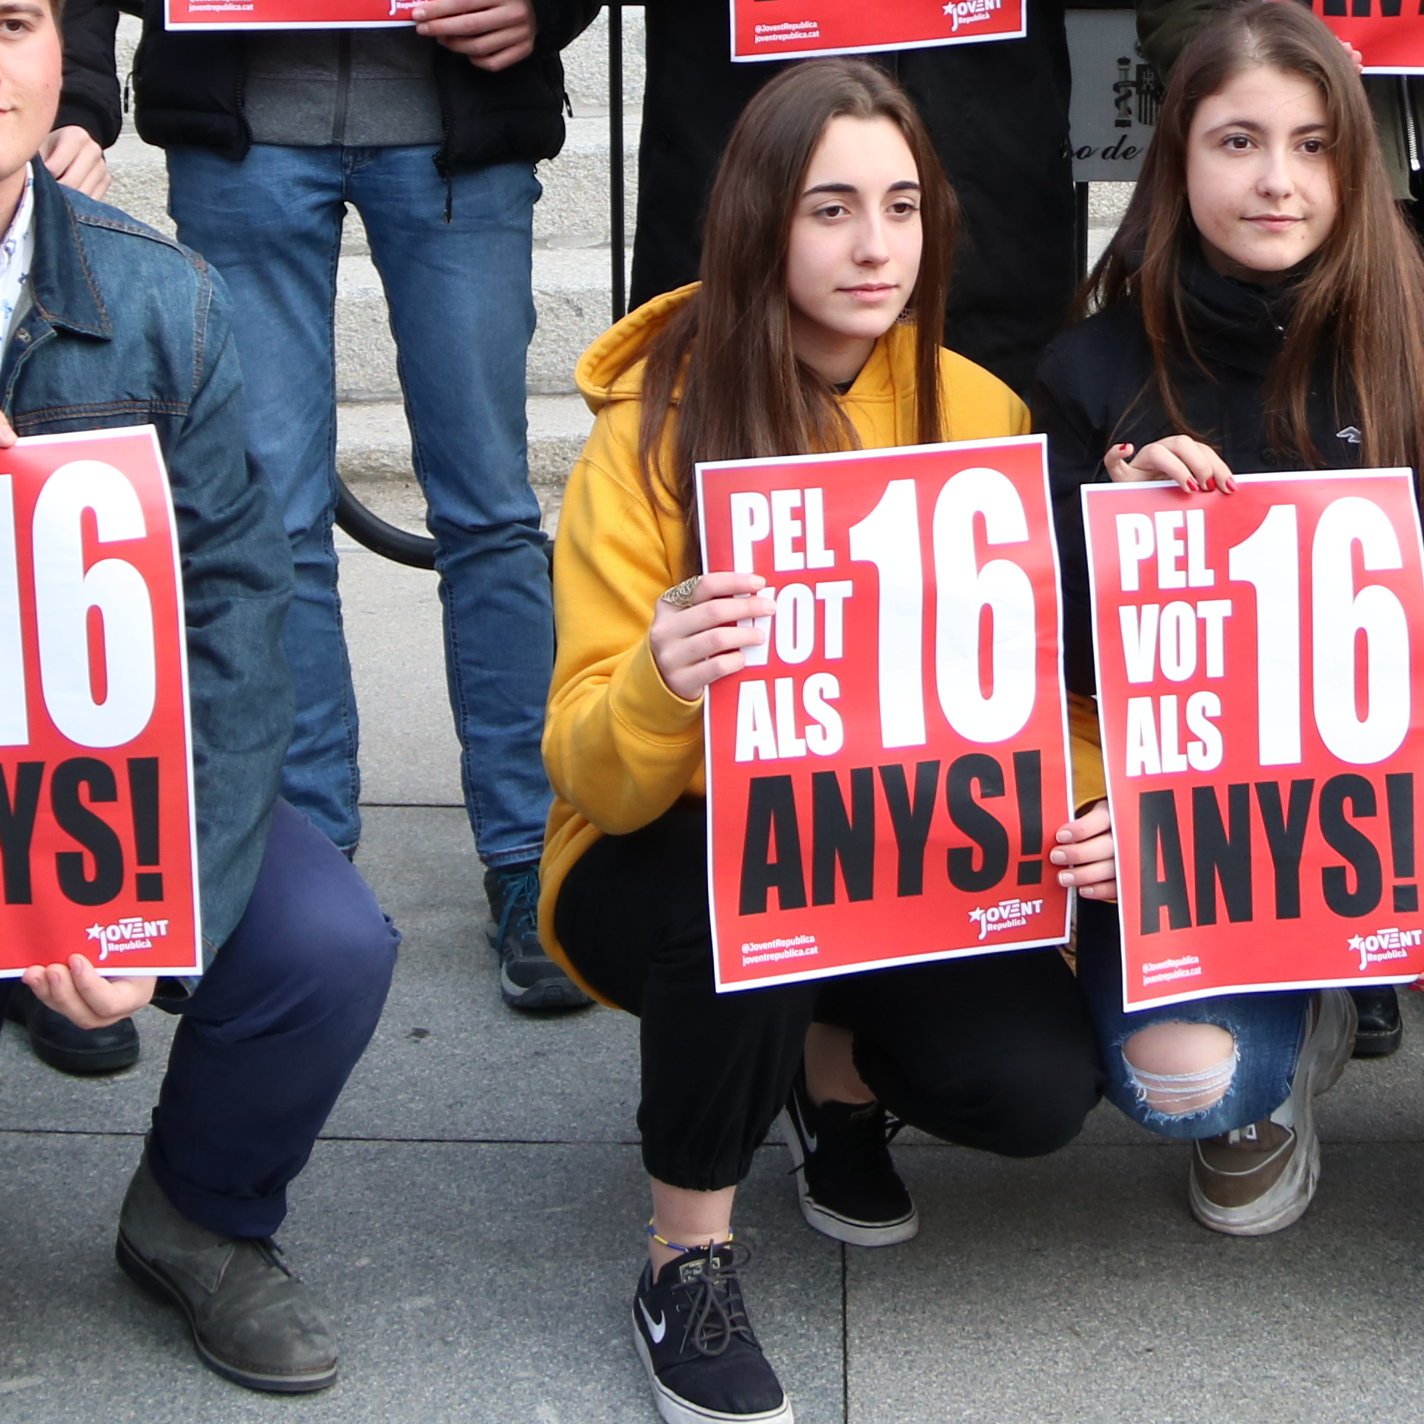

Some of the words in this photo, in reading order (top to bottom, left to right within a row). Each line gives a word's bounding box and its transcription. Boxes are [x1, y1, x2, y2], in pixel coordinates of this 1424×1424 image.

[189, 4, 253, 12] joventrepublica.cat
[755, 21, 817, 33] @JoventRepublica
[755, 31, 819, 43] joventrepublica.cat
[729, 487, 835, 574] PEL
[1115, 508, 1215, 592] PEL
[848, 467, 1037, 749] 16
[1228, 496, 1412, 766] 16
[1119, 599, 1233, 684] VOT
[734, 672, 844, 764] ALS
[1124, 691, 1223, 777] ALS
[738, 749, 1043, 917] ANYS!
[1139, 771, 1419, 936] ANYS!
[99, 917, 168, 960] JOVENT
[108, 940, 152, 951] Republicà
[742, 935, 815, 953] @JoventRepublica
[978, 898, 1043, 940] JOVENT
[1358, 929, 1423, 970] JOVENT
[742, 945, 818, 967] joventrepublica.cat
